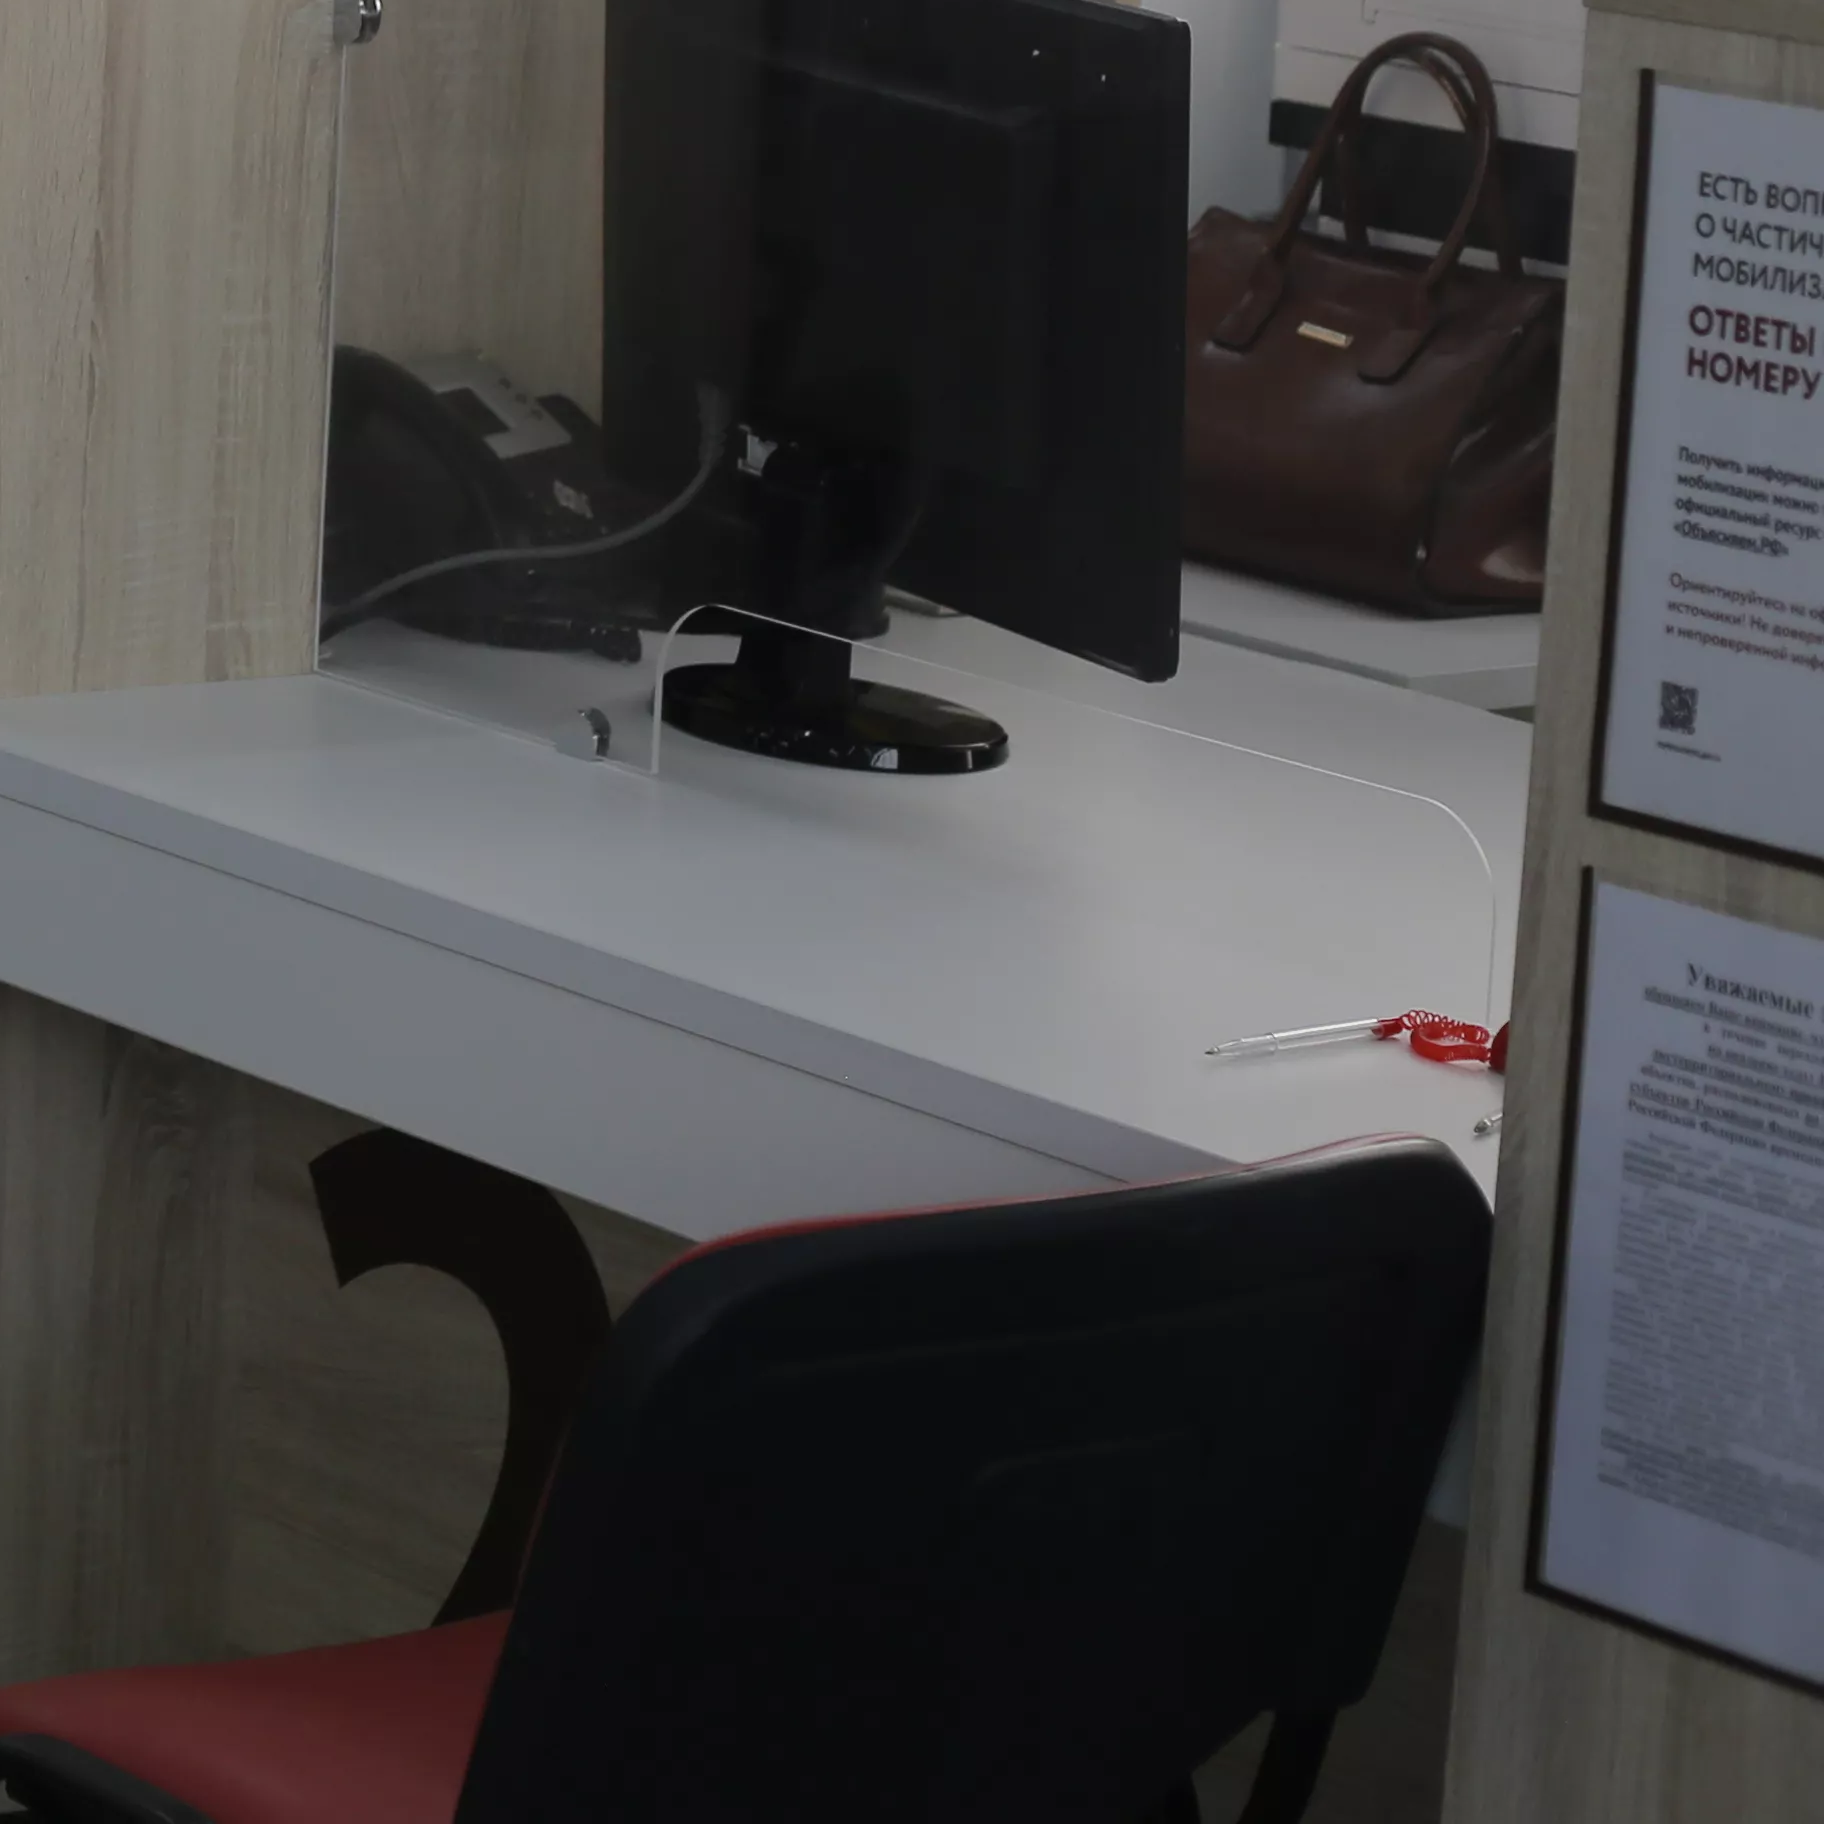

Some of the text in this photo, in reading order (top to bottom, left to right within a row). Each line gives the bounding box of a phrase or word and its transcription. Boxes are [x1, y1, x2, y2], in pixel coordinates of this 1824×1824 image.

[1699, 171, 1758, 206] ЕСТЬ
[1695, 213, 1824, 259] О ЧАСТИЧ
[1693, 252, 1824, 300] МОБИЛИЗ
[1688, 304, 1816, 357] ОТВЕТЫ
[1686, 346, 1821, 400] НОМЕРУ
[1679, 445, 1742, 473] Получить
[1674, 496, 1770, 528] официальный
[1773, 494, 1819, 514] можно
[1669, 571, 1785, 612] Ориентируйтесь
[1667, 600, 1746, 626] источники!
[1750, 615, 1769, 632] Не
[1687, 961, 1814, 1018] Уважаемые
